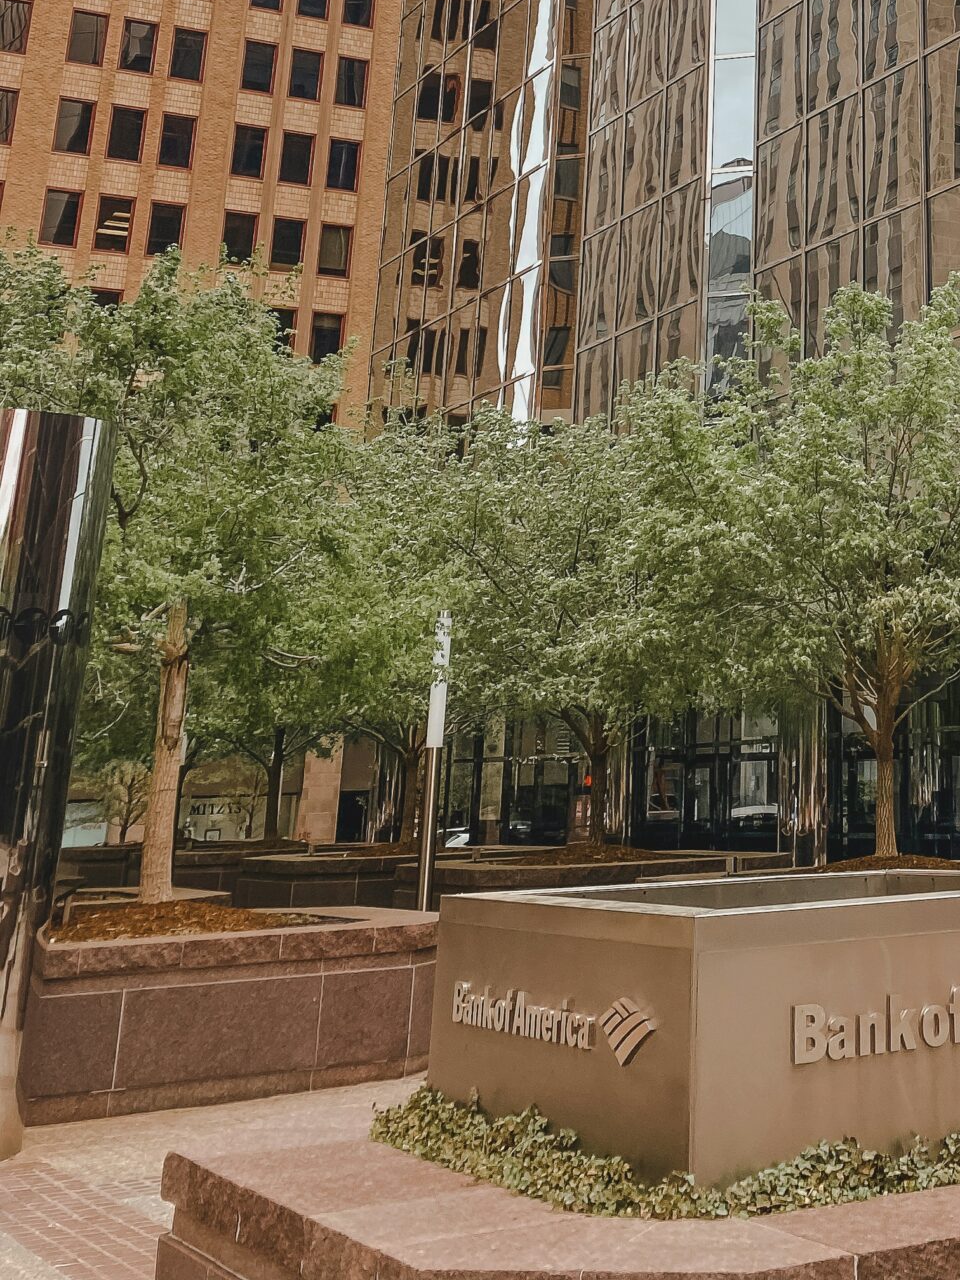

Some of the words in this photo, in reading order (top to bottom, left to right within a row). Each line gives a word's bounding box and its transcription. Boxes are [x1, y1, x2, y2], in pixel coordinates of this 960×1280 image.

[452, 981, 493, 1030] Bank
[494, 988, 516, 1033] of
[512, 990, 596, 1050] America
[792, 993, 916, 1065] Bank
